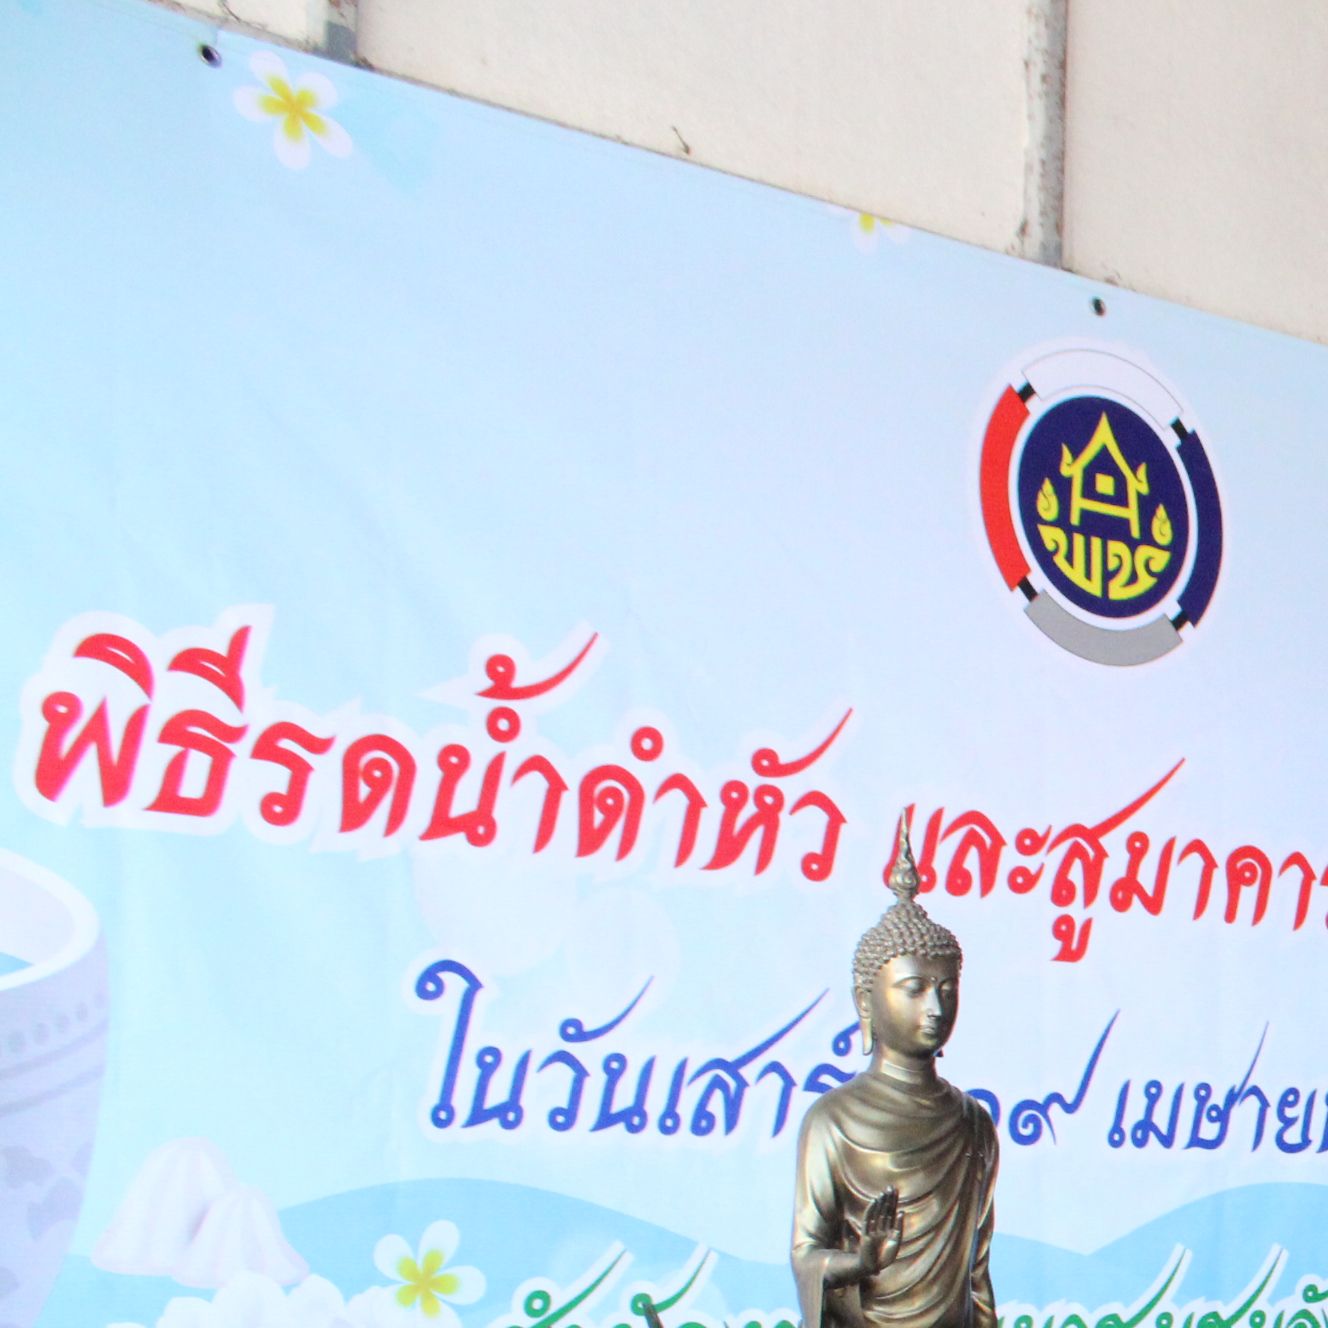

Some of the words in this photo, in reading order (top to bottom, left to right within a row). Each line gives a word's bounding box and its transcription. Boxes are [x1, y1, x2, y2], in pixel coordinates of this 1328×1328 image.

[34, 624, 854, 883] พิธีรดน้ำดำหัว
